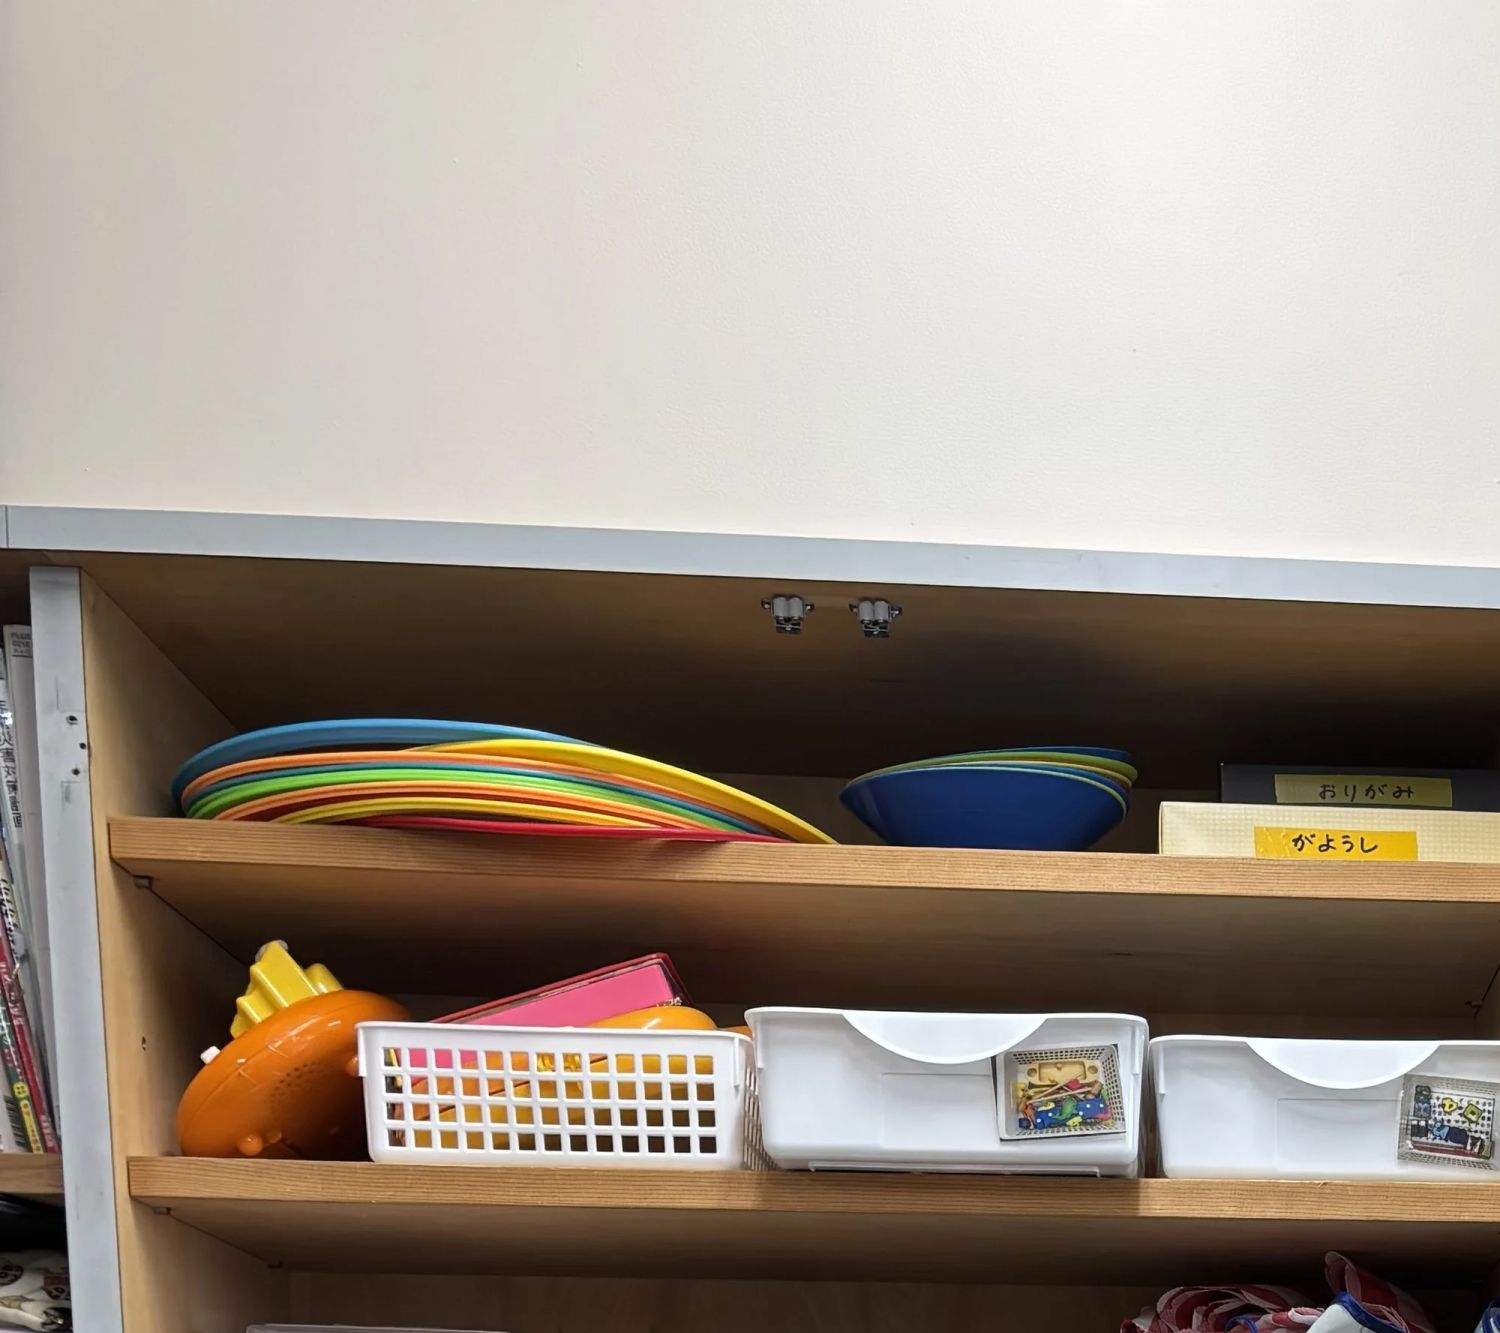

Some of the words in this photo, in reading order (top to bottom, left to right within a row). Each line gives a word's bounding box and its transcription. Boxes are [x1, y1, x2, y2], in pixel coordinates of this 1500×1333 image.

[1319, 783, 1415, 802] おりがみ
[1291, 833, 1379, 853] がようし
